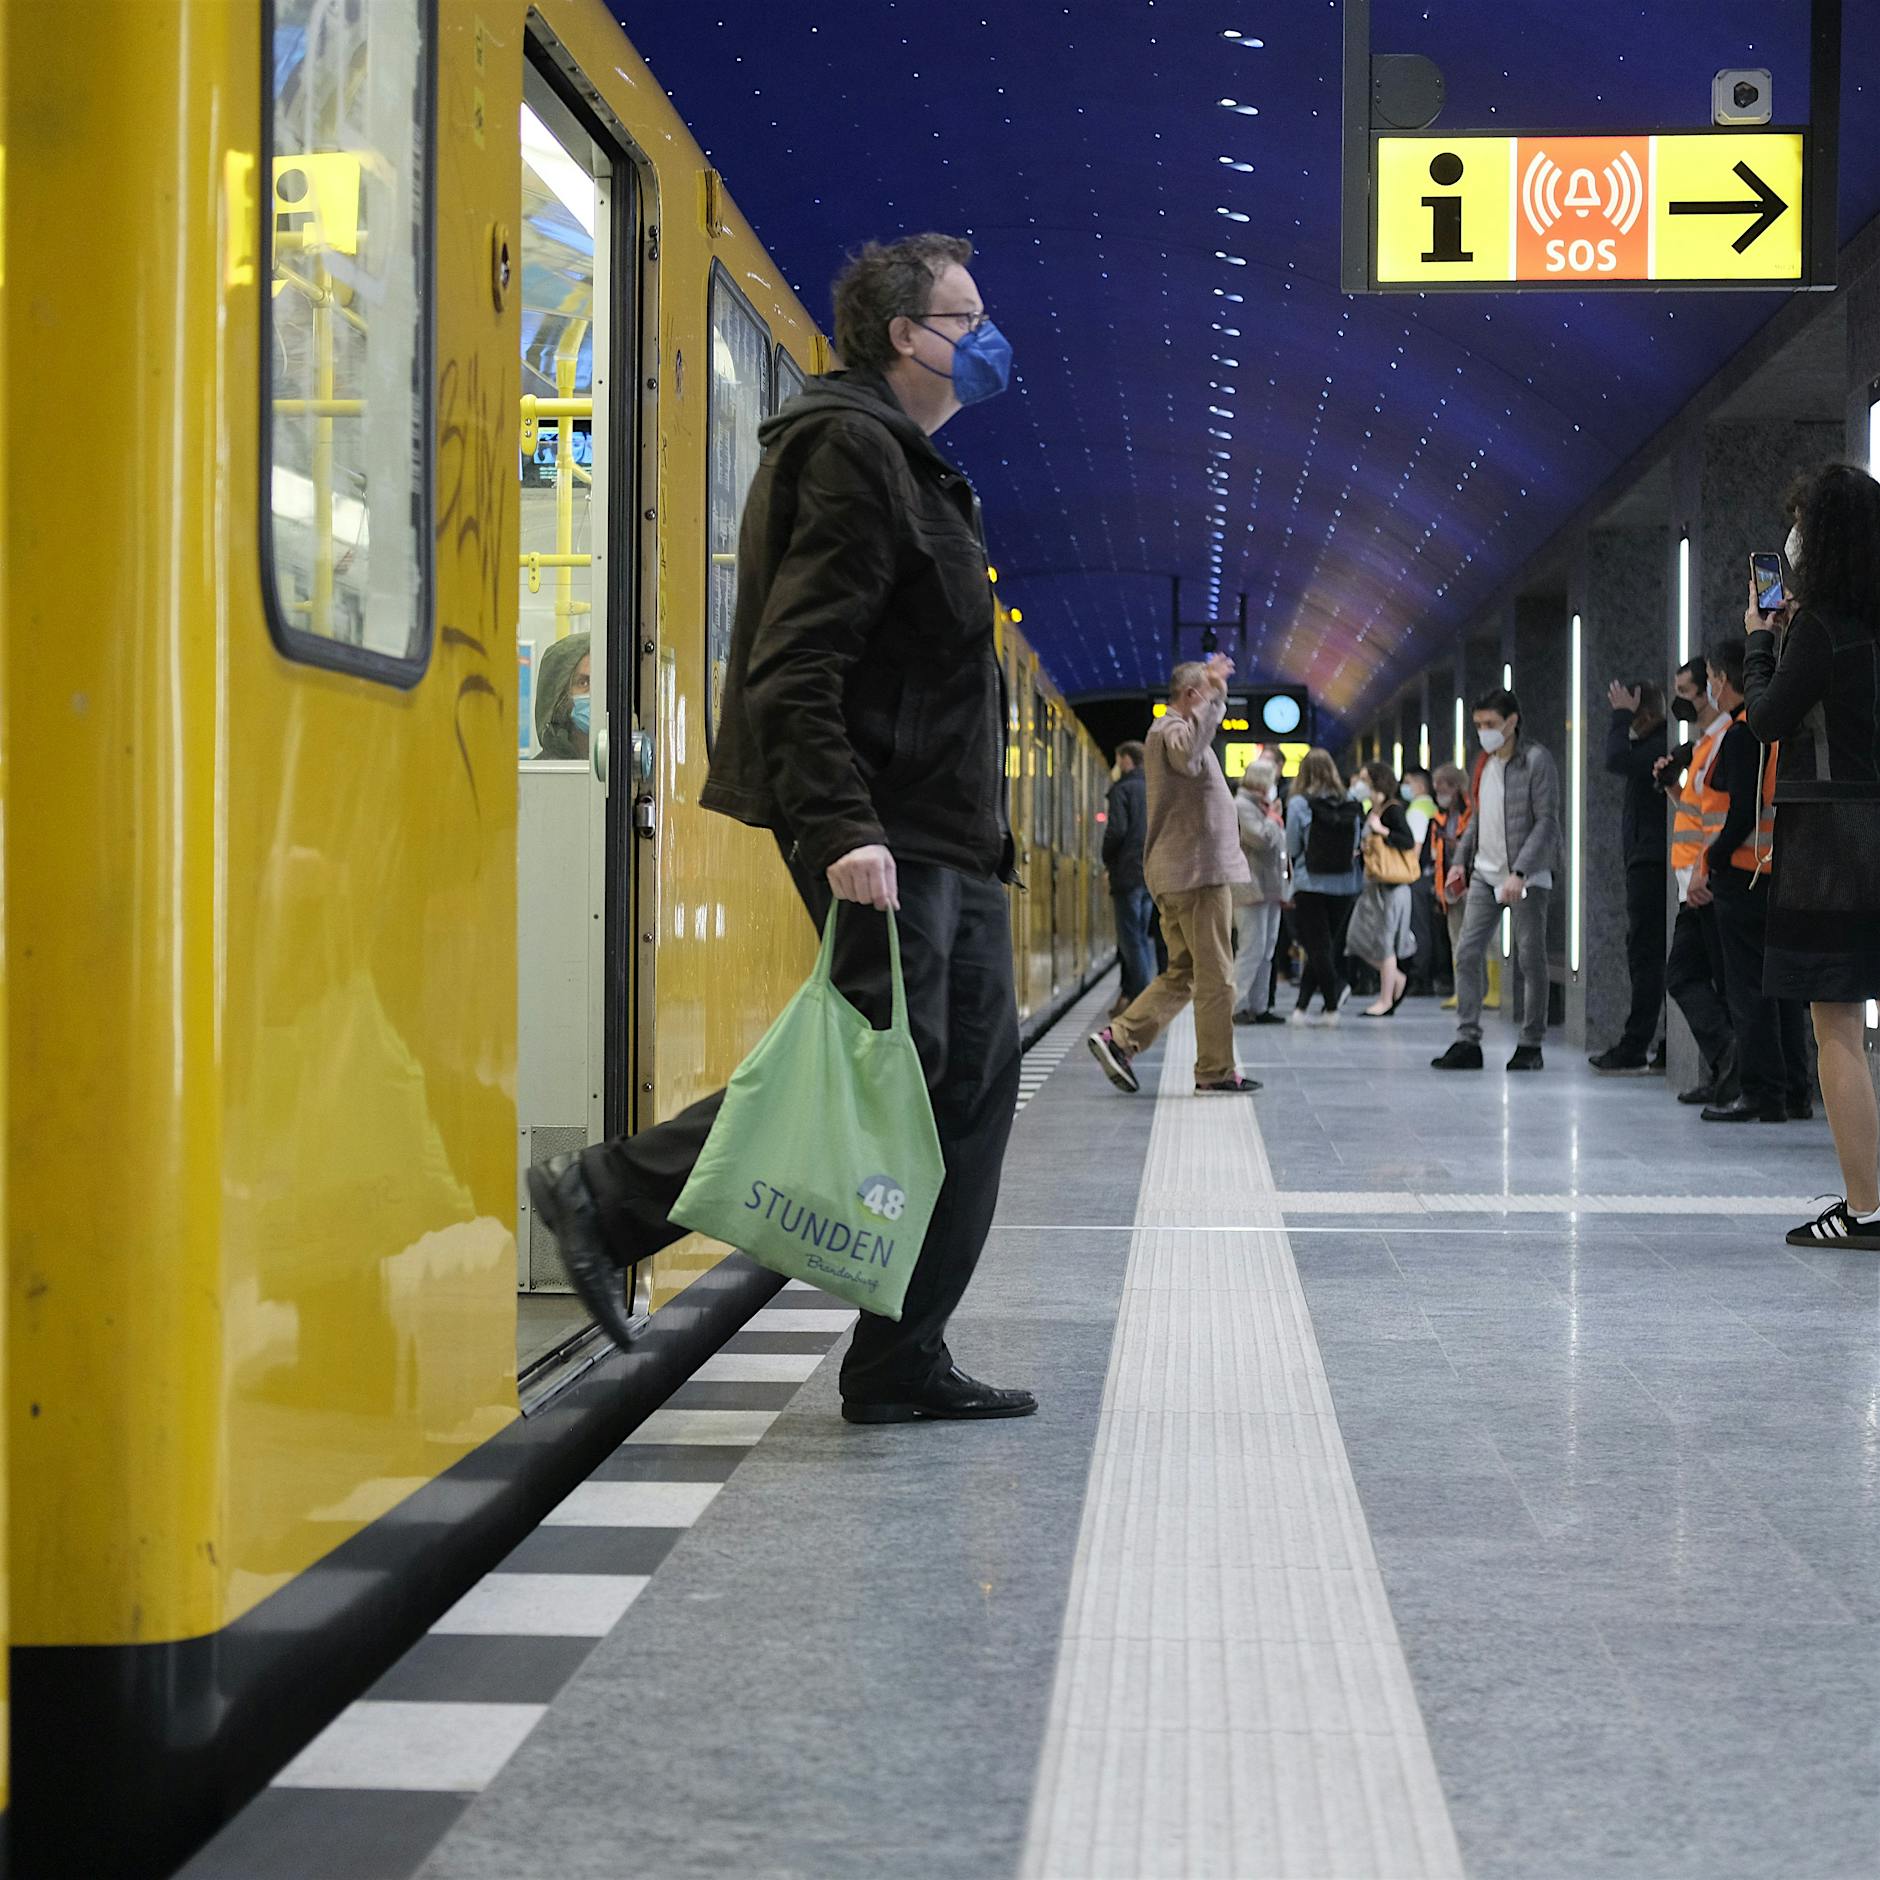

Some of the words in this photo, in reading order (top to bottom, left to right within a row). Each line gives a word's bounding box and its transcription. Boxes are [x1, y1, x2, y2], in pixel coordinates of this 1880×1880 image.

[1545, 238, 1617, 273] SOS
[863, 1183, 906, 1222] 48
[744, 1179, 895, 1269] STUNDEN
